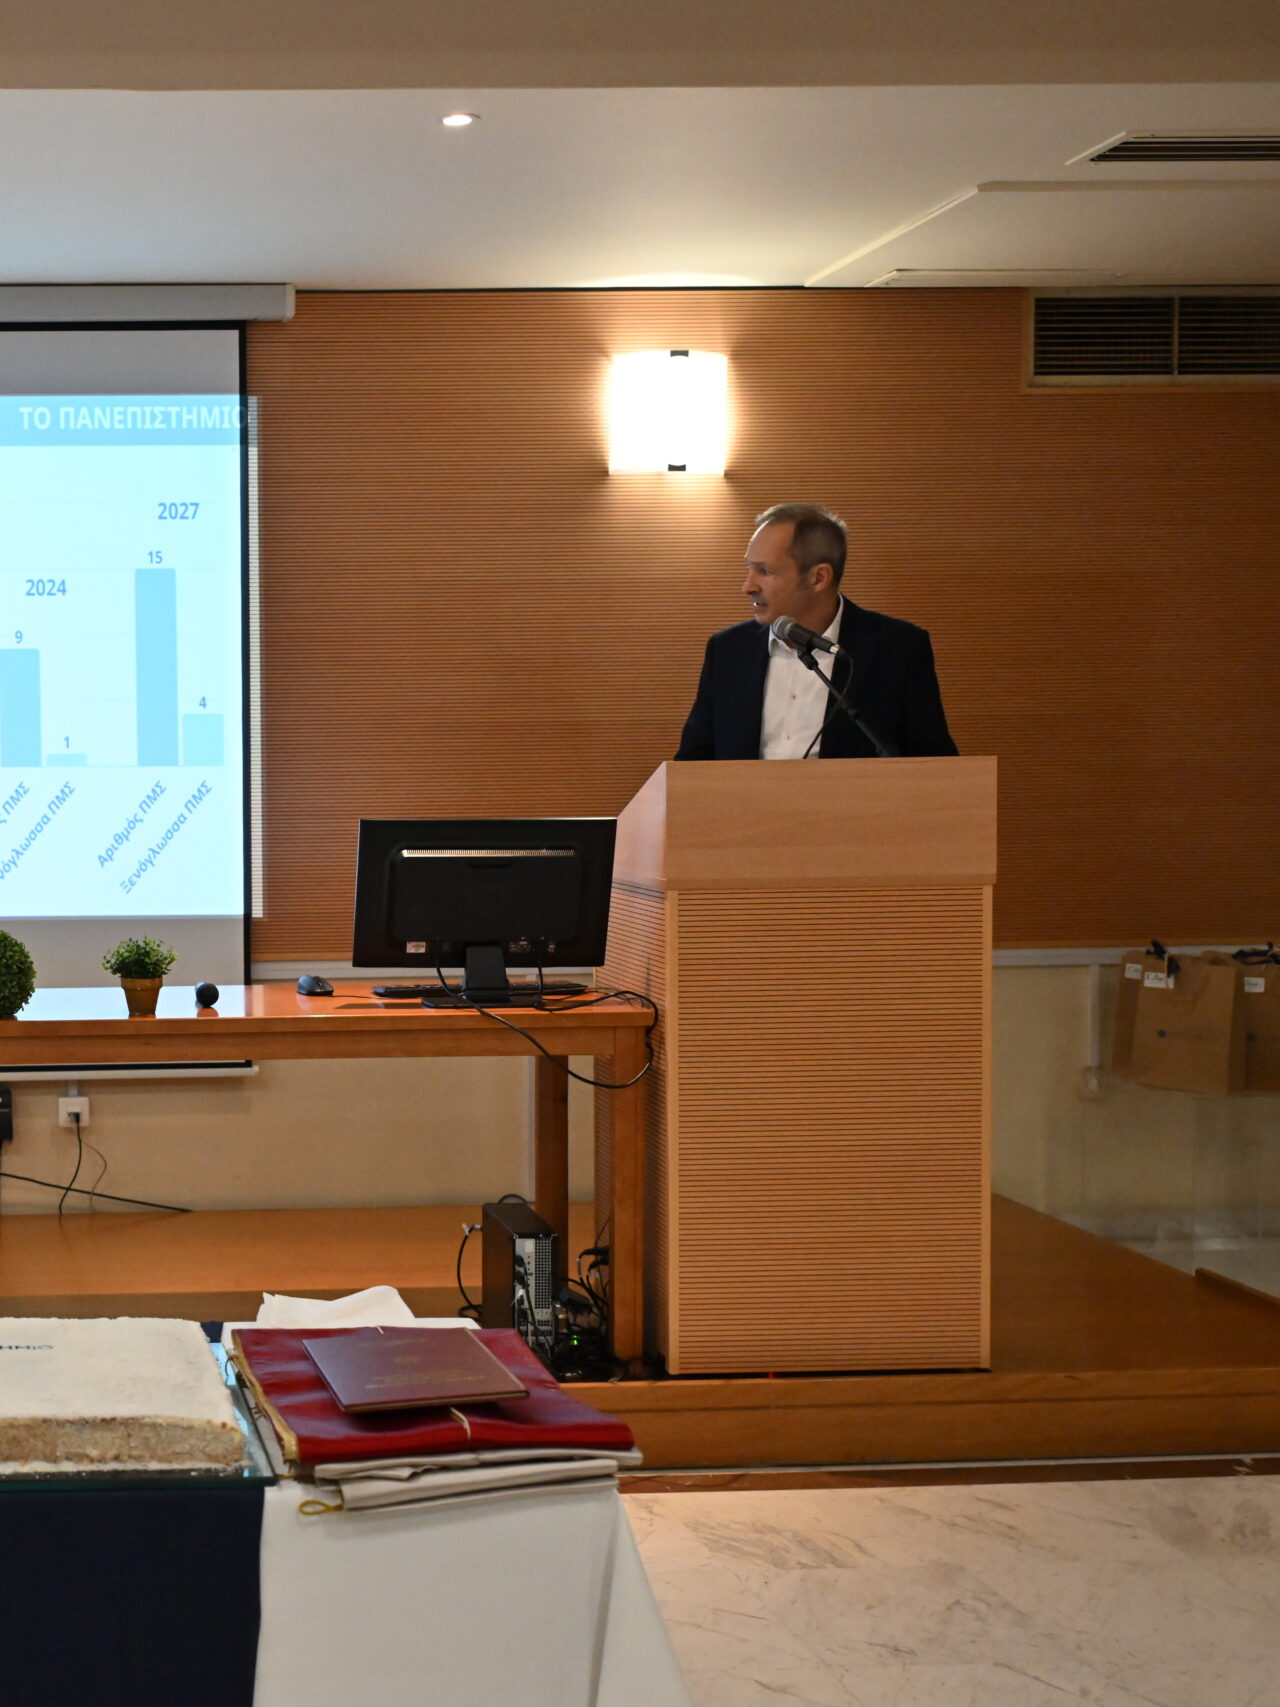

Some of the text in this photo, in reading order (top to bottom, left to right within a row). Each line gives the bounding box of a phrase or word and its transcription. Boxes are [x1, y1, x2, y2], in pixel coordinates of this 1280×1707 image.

[19, 407, 51, 429] ΤΟ
[157, 503, 199, 520] 2027
[147, 551, 163, 564] 15
[25, 579, 67, 596] 2024
[15, 631, 23, 644] 9
[198, 696, 207, 709] 4
[64, 736, 70, 749] 1
[2, 781, 30, 814] ΠΜΣ
[47, 780, 77, 815] ΠΜΣ
[97, 780, 168, 868] Αριθμός ΠΜΣ
[120, 780, 214, 894] Ξενόγλωσσα ΠΜΣ
